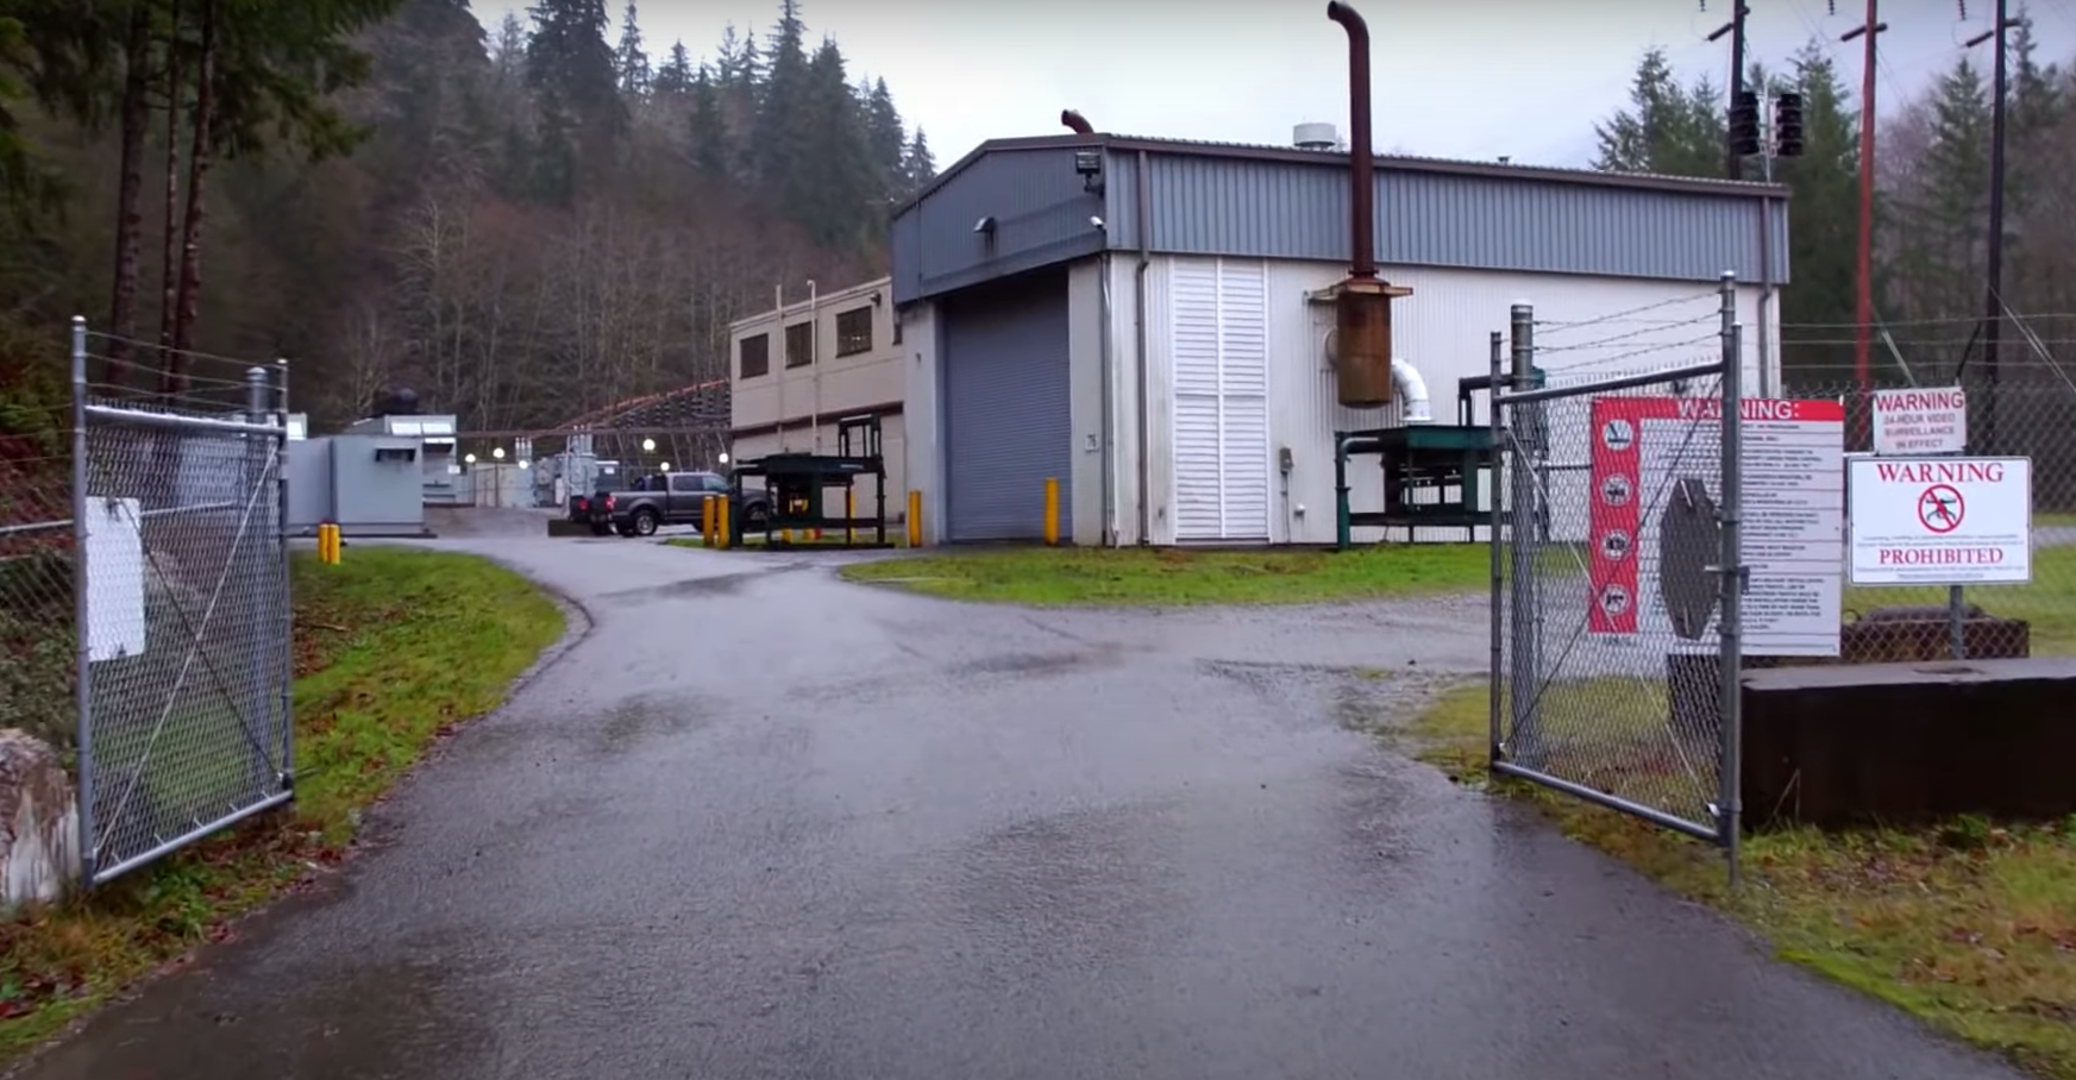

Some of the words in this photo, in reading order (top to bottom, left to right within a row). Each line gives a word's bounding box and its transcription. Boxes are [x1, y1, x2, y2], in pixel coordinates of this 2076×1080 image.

[1677, 400, 1799, 419] WANING:
[1876, 391, 1964, 412] WARNING
[1926, 412, 1956, 424] VIDEO
[1884, 426, 1955, 437] SURVEILLANCE
[1908, 439, 1943, 449] EFFECT
[1877, 463, 2004, 482] WARNING
[1879, 548, 2004, 565] PROHIBITED
